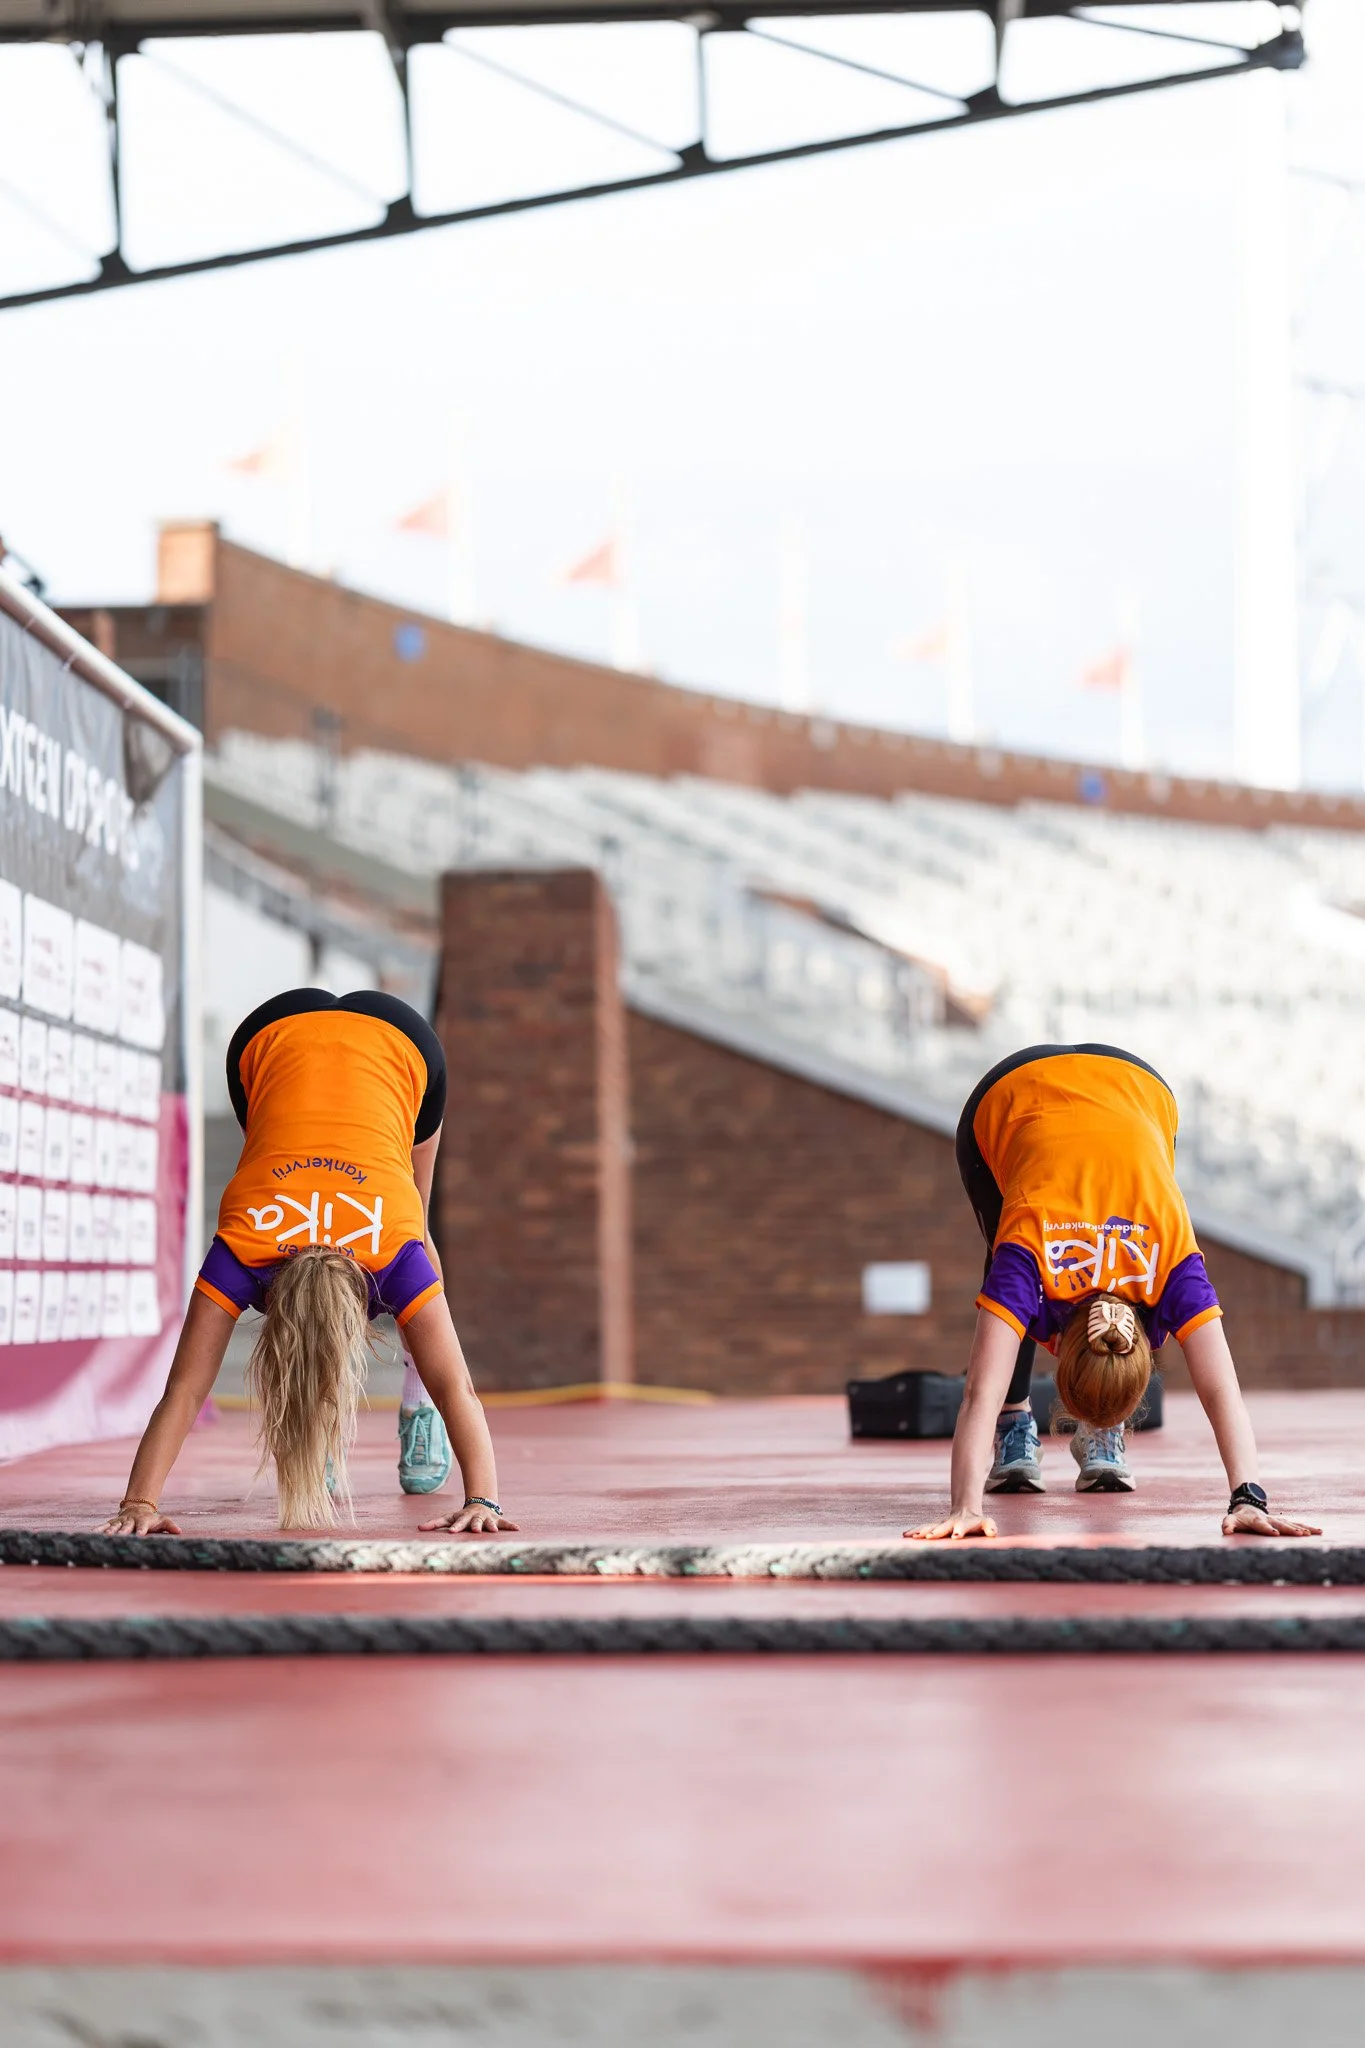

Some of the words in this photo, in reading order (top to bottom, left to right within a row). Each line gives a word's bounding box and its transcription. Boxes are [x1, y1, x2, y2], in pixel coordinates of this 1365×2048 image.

[273, 1158, 367, 1184] Kankervrij
[247, 1191, 383, 1255] KiKa
[277, 1243, 355, 1258] Kien
[1045, 1233, 1159, 1295] KiKa
